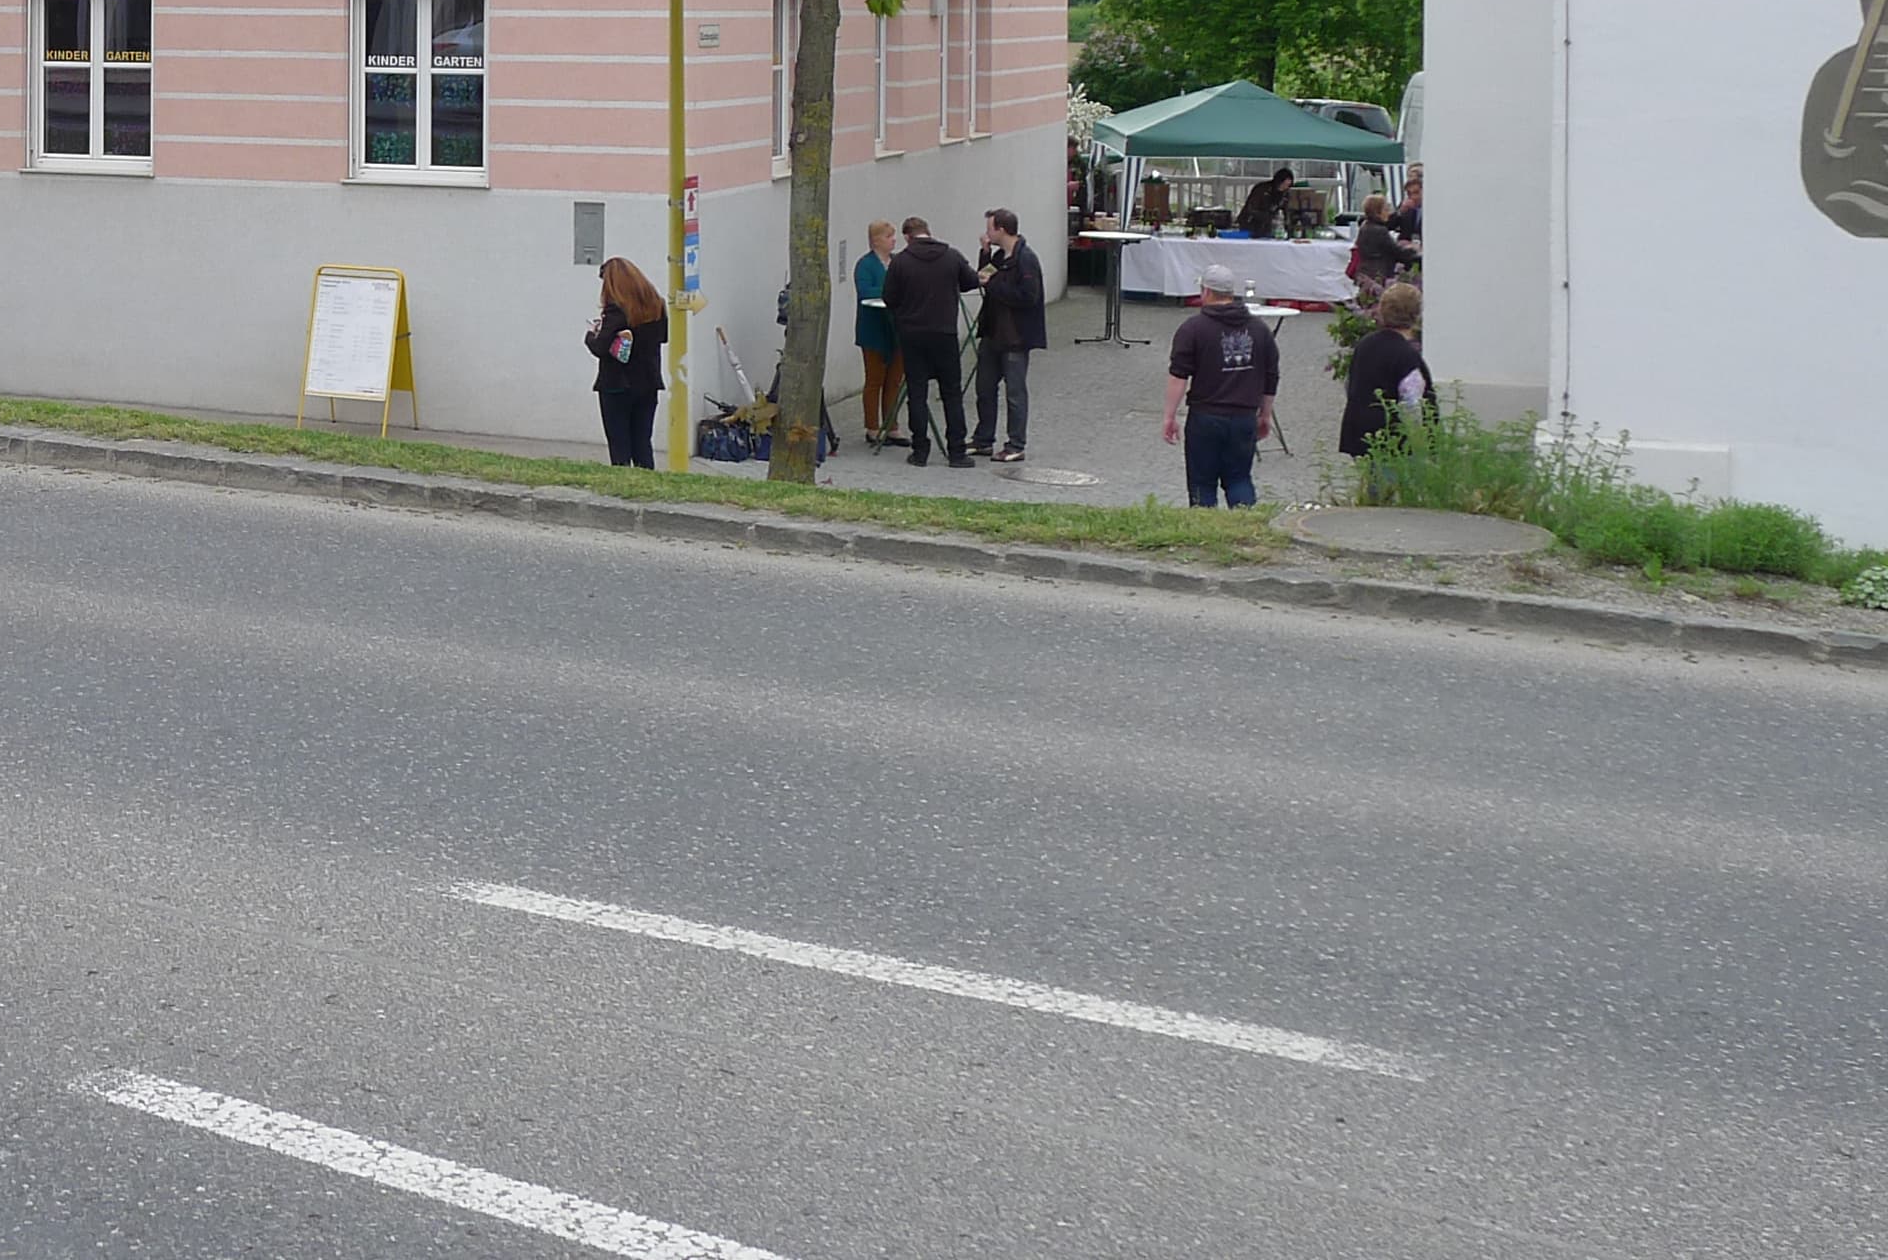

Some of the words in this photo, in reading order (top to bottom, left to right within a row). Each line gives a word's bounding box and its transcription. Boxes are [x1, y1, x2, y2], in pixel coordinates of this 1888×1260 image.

[46, 50, 89, 61] KINDER
[106, 51, 150, 61] GARTEN
[368, 55, 416, 67] KINDER
[433, 56, 482, 67] GARTEN
